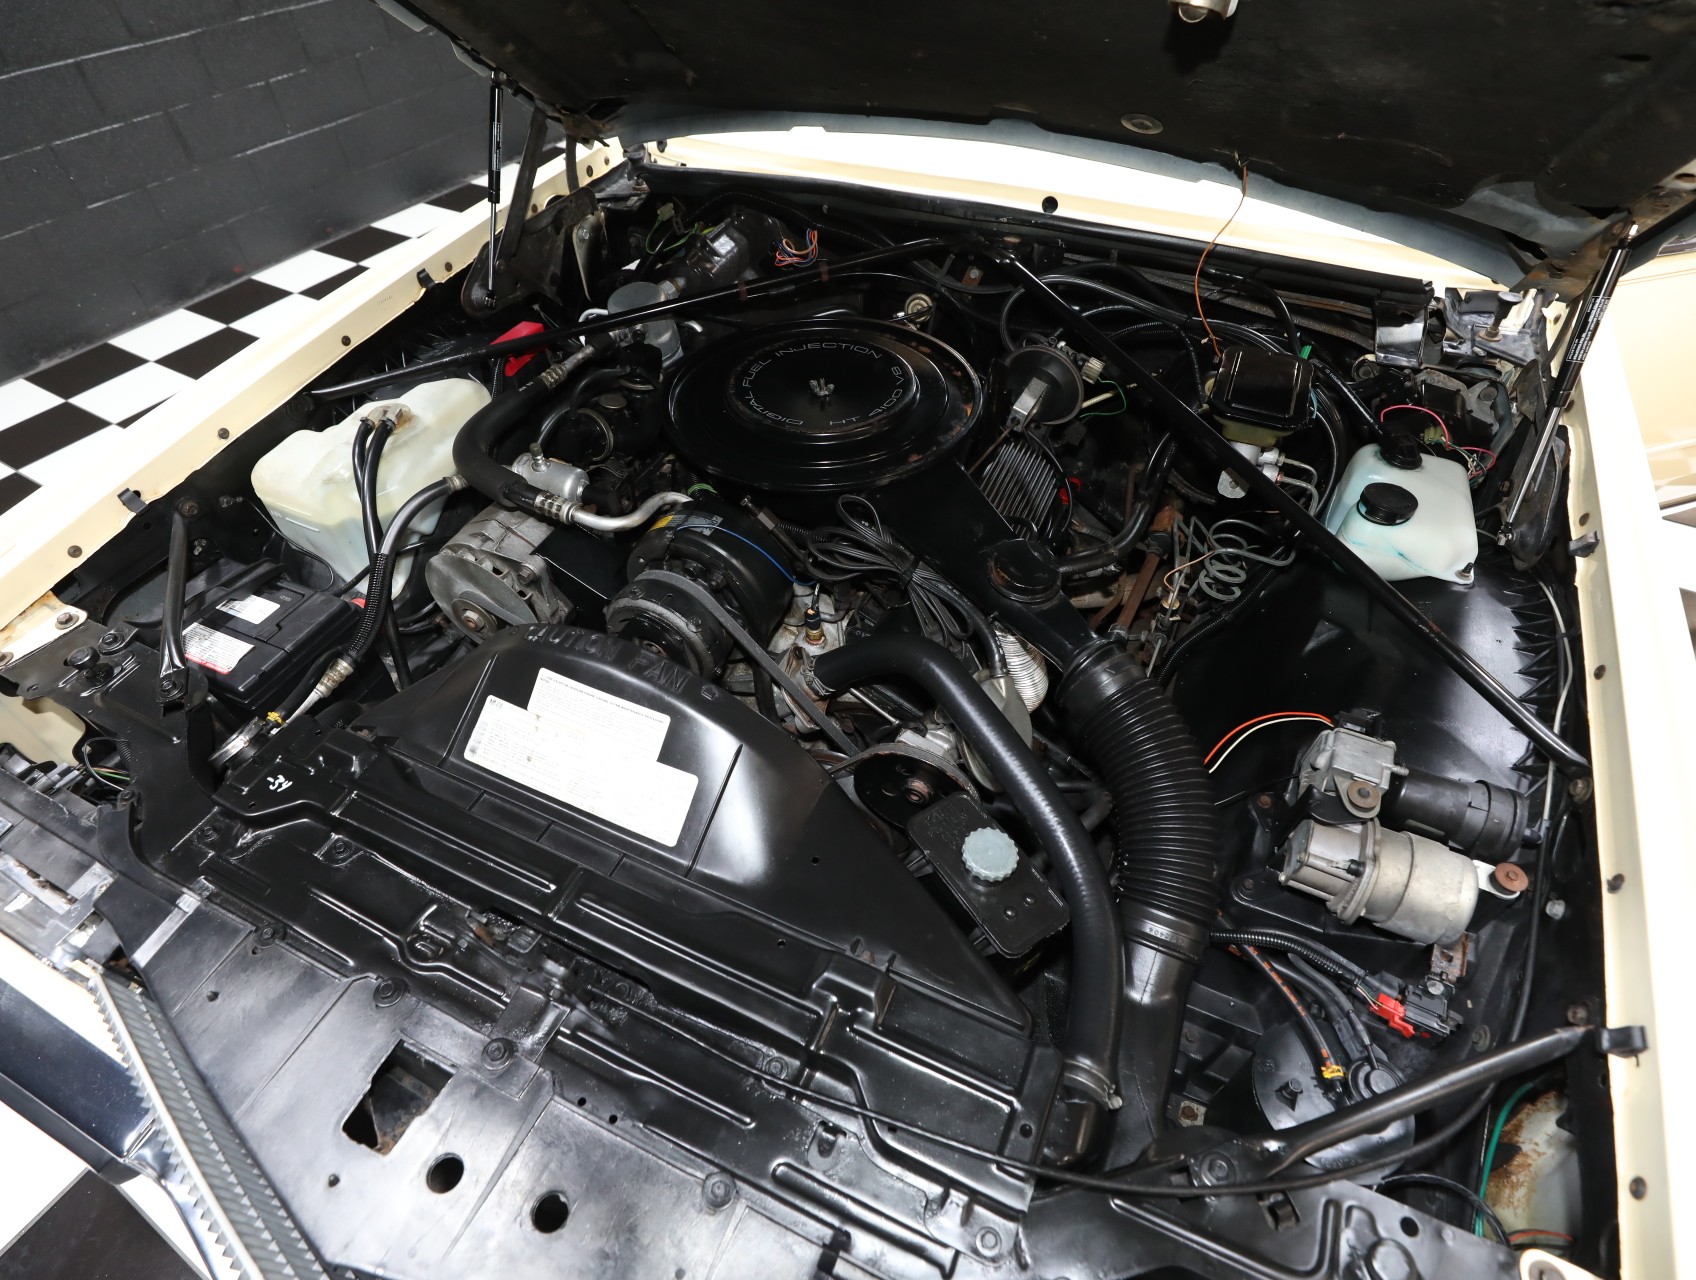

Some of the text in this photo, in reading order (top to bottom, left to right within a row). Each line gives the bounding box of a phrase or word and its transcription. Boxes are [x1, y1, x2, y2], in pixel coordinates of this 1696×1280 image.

[742, 342, 882, 426] DIGITAL FUEL INJECTION
[830, 366, 904, 426] HT 4100 V8
[627, 652, 696, 694] FAN
